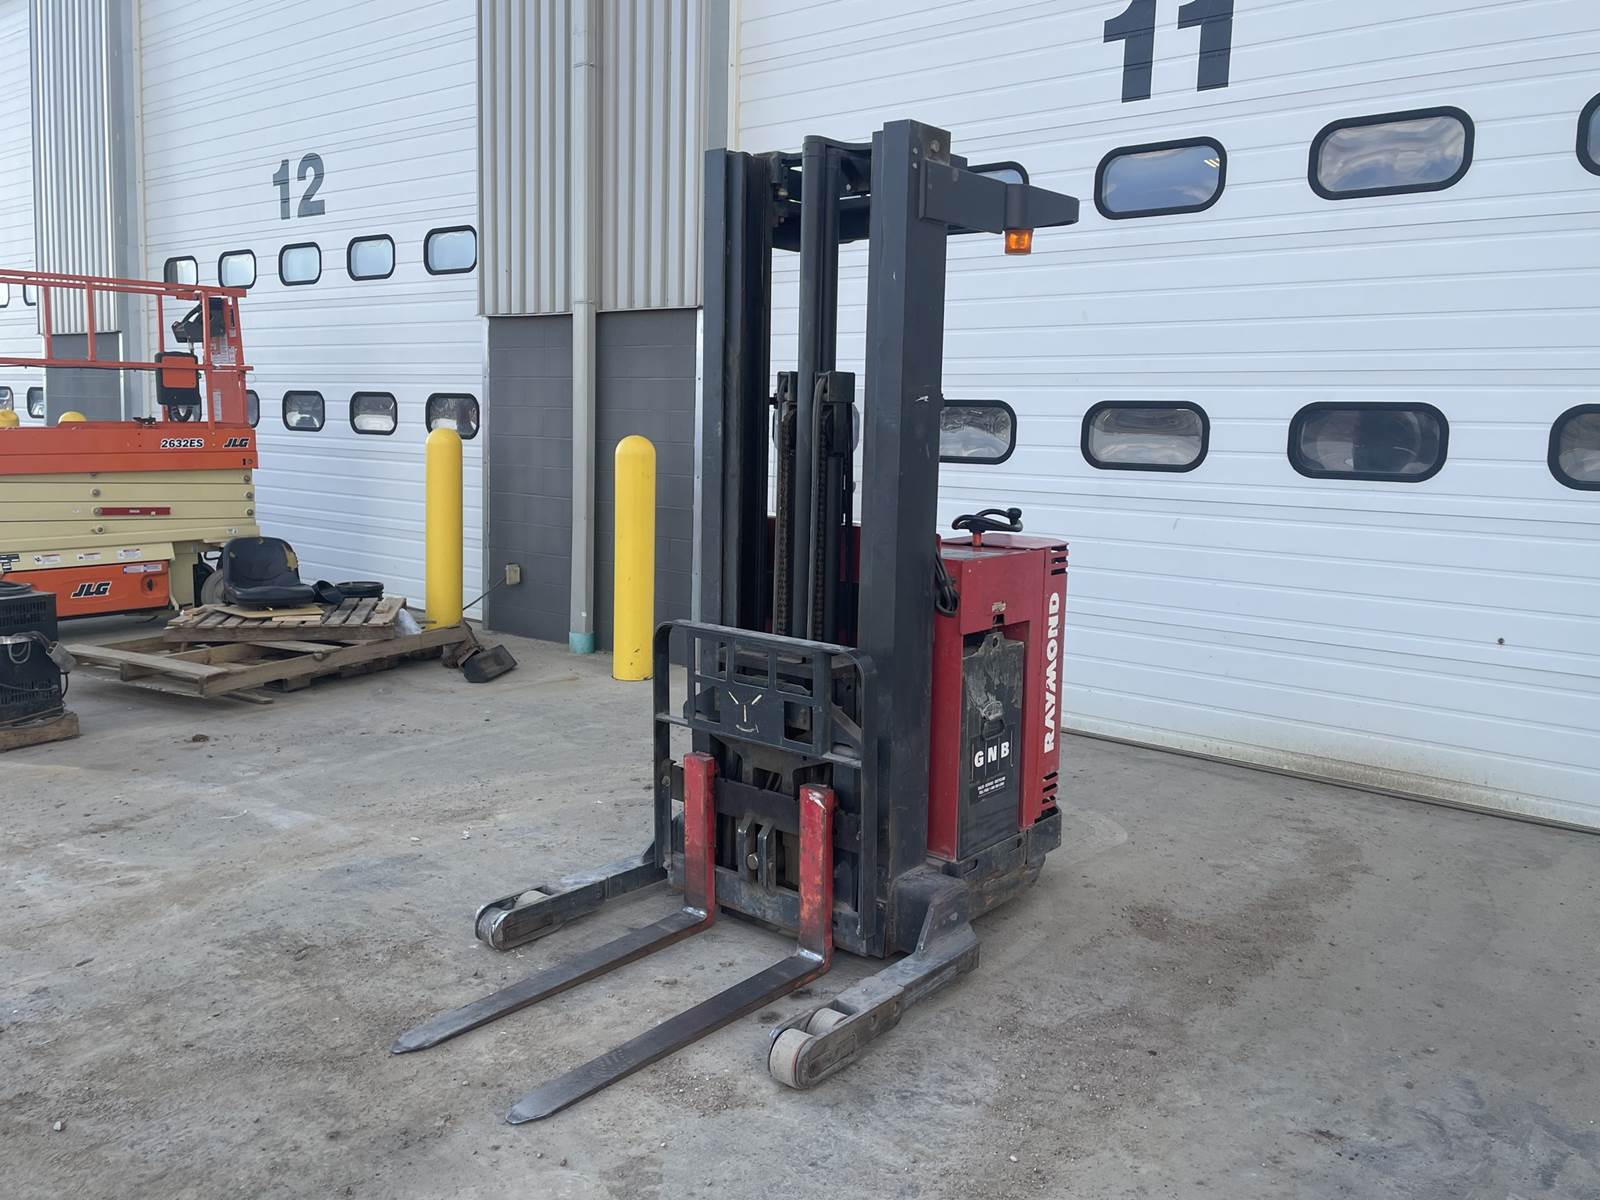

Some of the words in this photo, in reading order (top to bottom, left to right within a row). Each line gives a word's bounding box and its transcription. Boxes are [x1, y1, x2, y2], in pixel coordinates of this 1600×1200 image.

[1103, 0, 1233, 103] 11
[272, 152, 326, 220] 12
[160, 438, 204, 449] 2632ES
[223, 438, 250, 449] JLG
[72, 582, 111, 598] JLG
[1043, 592, 1060, 753] RAYMOND
